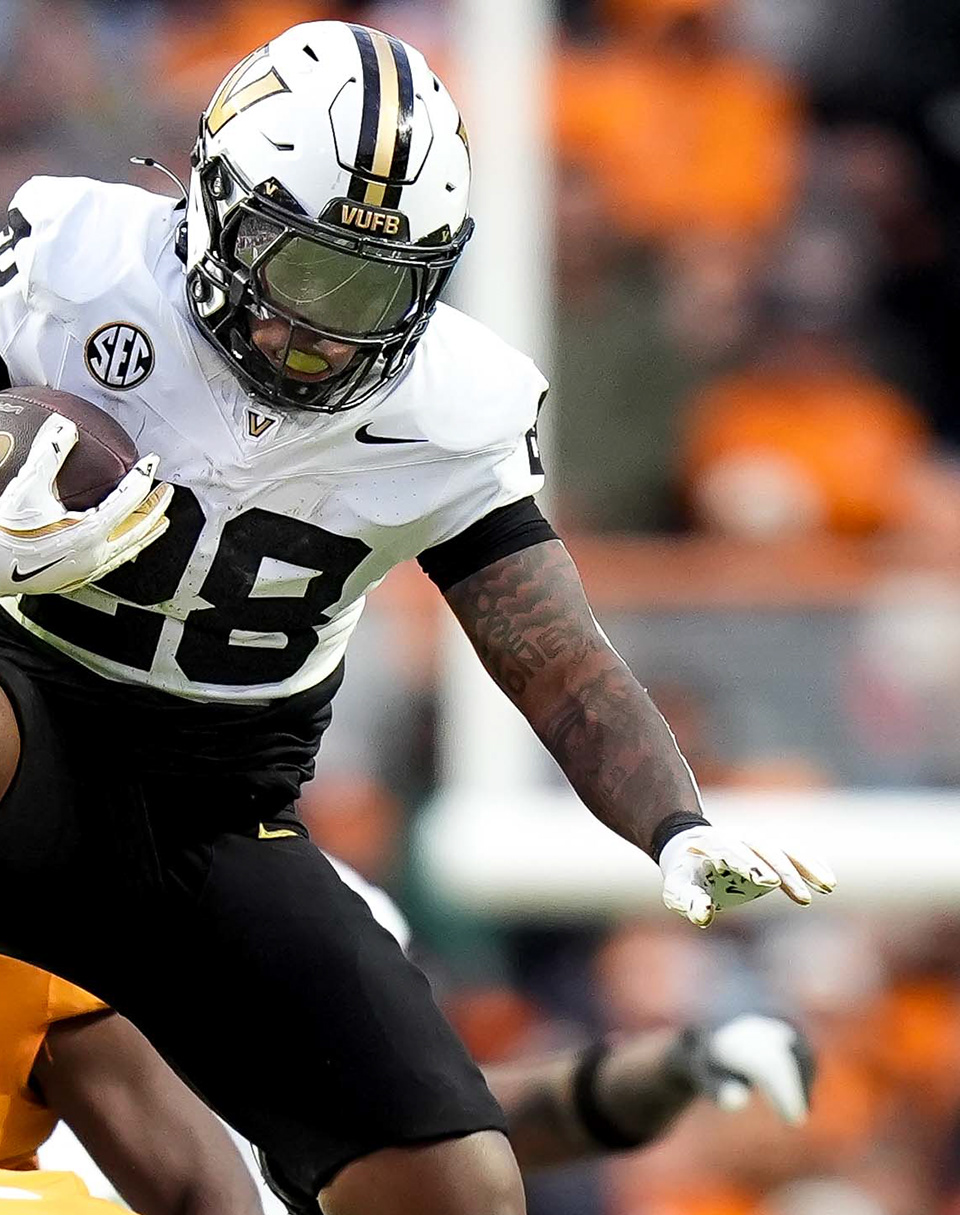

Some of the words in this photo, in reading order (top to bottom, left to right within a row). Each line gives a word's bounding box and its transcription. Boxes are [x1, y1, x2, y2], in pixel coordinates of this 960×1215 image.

[341, 204, 401, 236] VUFB
[89, 325, 150, 387] SEC
[247, 410, 276, 438] V
[18, 478, 373, 686] 28
